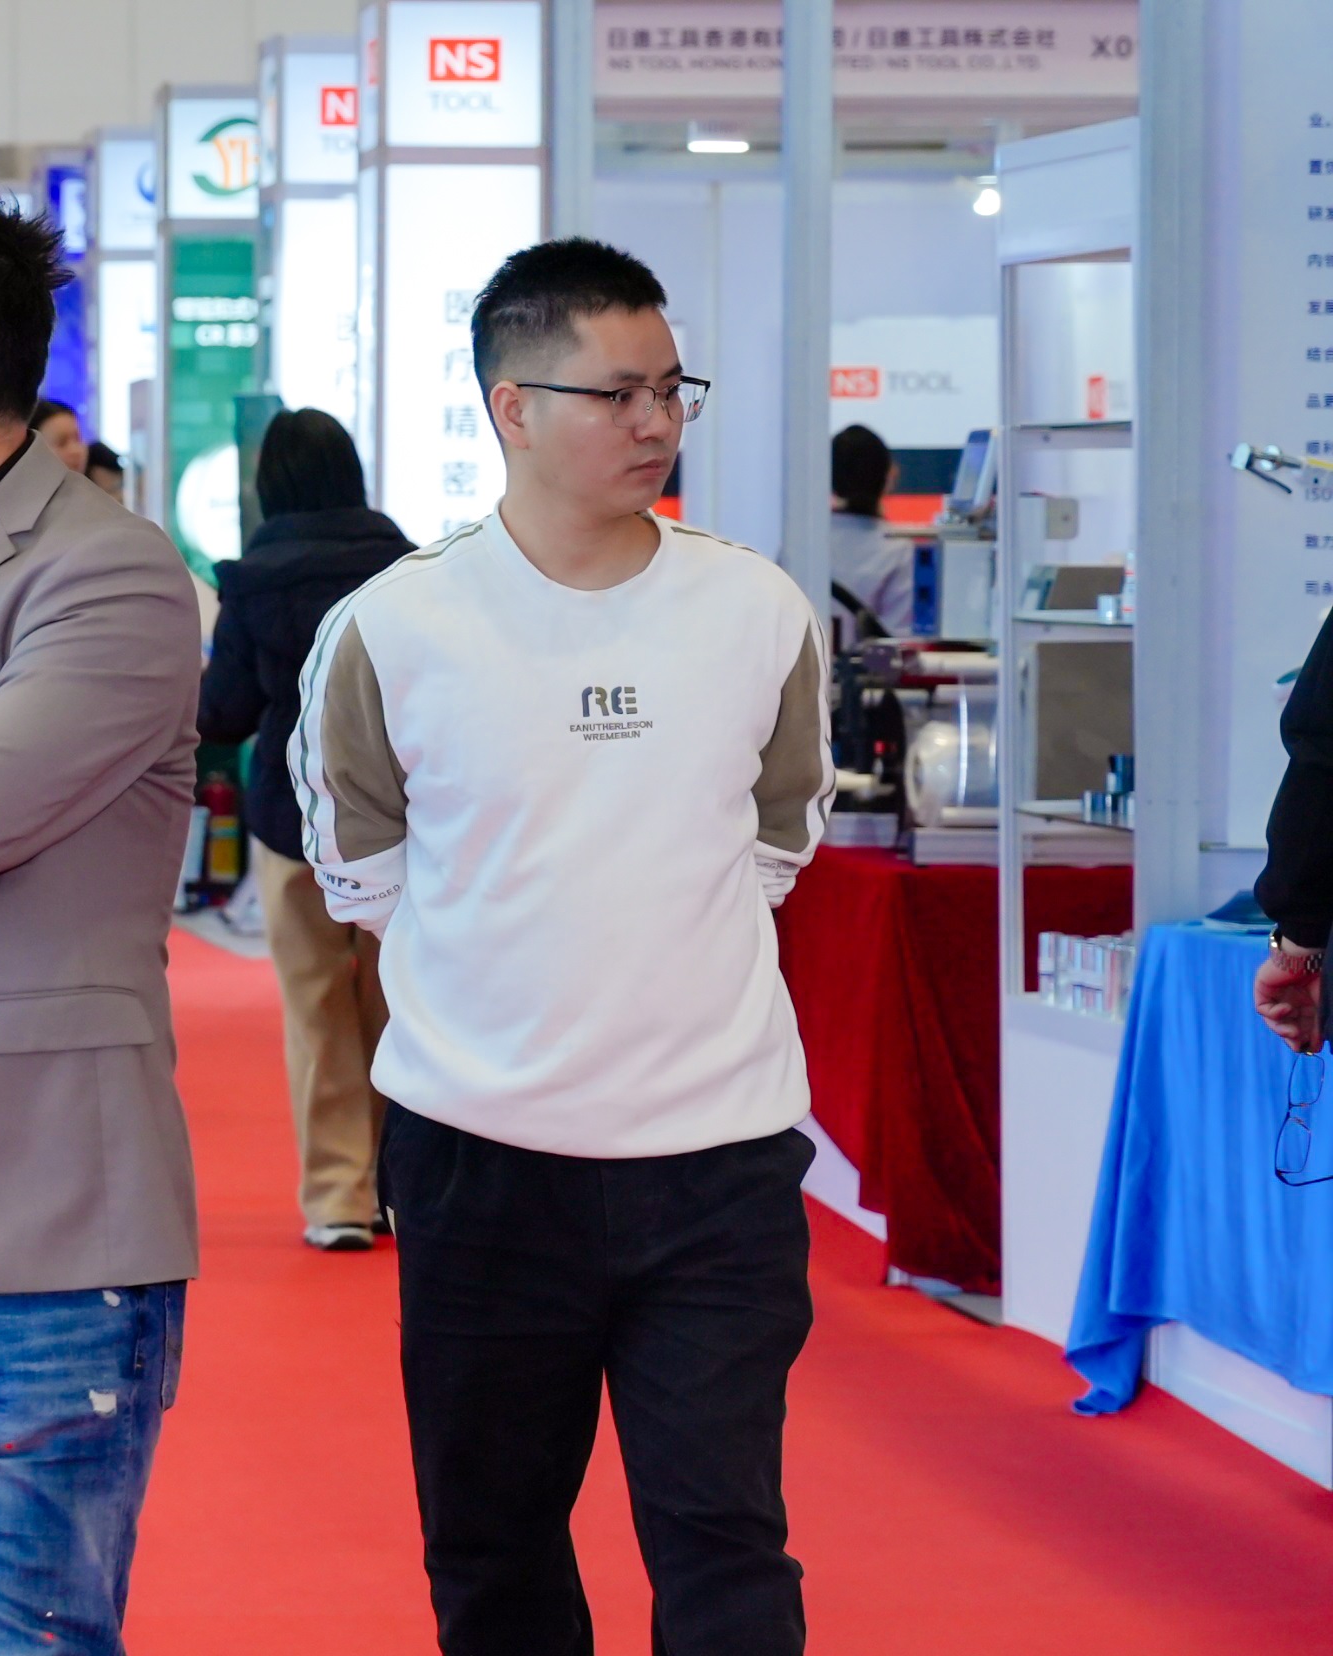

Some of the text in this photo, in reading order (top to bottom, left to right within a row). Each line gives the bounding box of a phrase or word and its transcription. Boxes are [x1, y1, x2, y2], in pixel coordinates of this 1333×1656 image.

[434, 42, 496, 78] NS
[1090, 34, 1134, 60] X0
[325, 90, 356, 122] N
[428, 90, 501, 113] TOOL
[888, 371, 959, 393] TOOL
